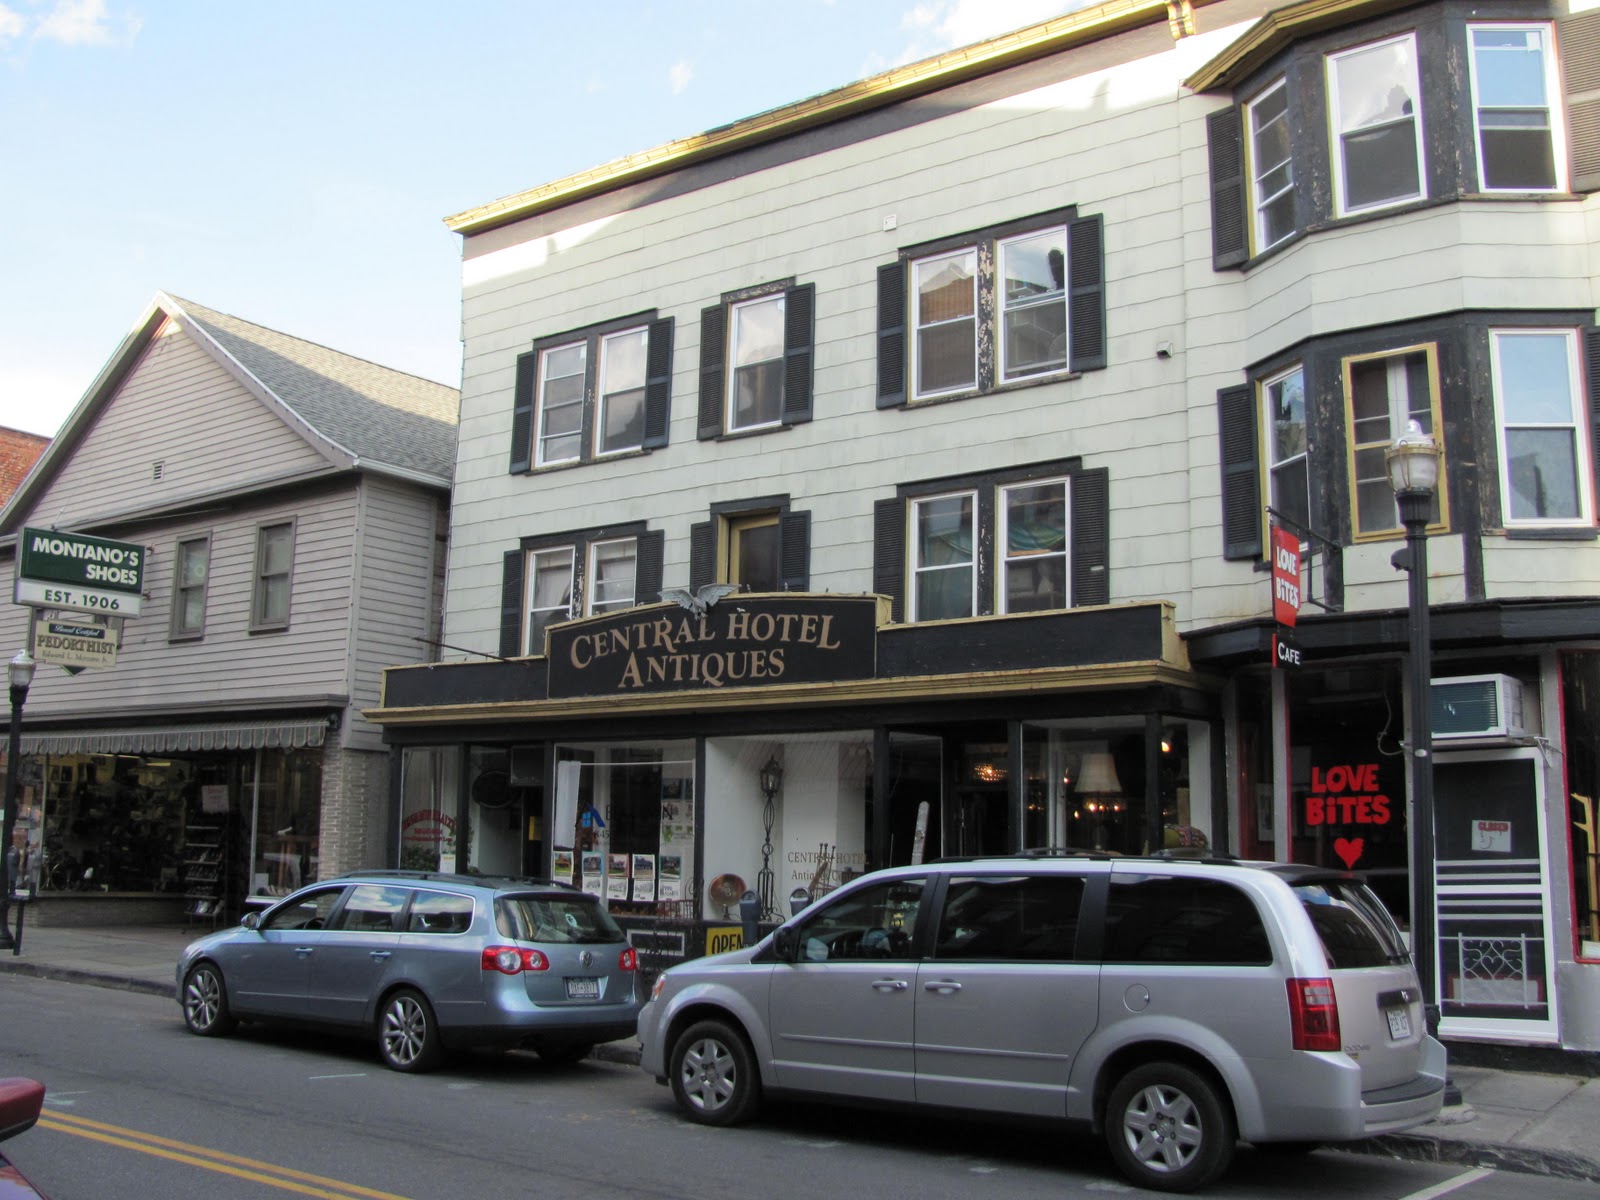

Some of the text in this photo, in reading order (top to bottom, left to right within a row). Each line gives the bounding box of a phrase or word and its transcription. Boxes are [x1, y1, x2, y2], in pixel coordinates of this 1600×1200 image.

[33, 537, 139, 567] MONTANO'S
[1276, 546, 1297, 577] LOVE
[86, 564, 138, 585] SHOES
[44, 589, 120, 610] EST. 1906
[37, 634, 115, 655] PEDORTHIST
[570, 613, 841, 669] CENTRAL HOTEL
[1278, 642, 1300, 665] CAFE
[617, 649, 785, 688] ANTIQUES
[1311, 764, 1379, 793] LOVE
[836, 852, 870, 865] HOTEL
